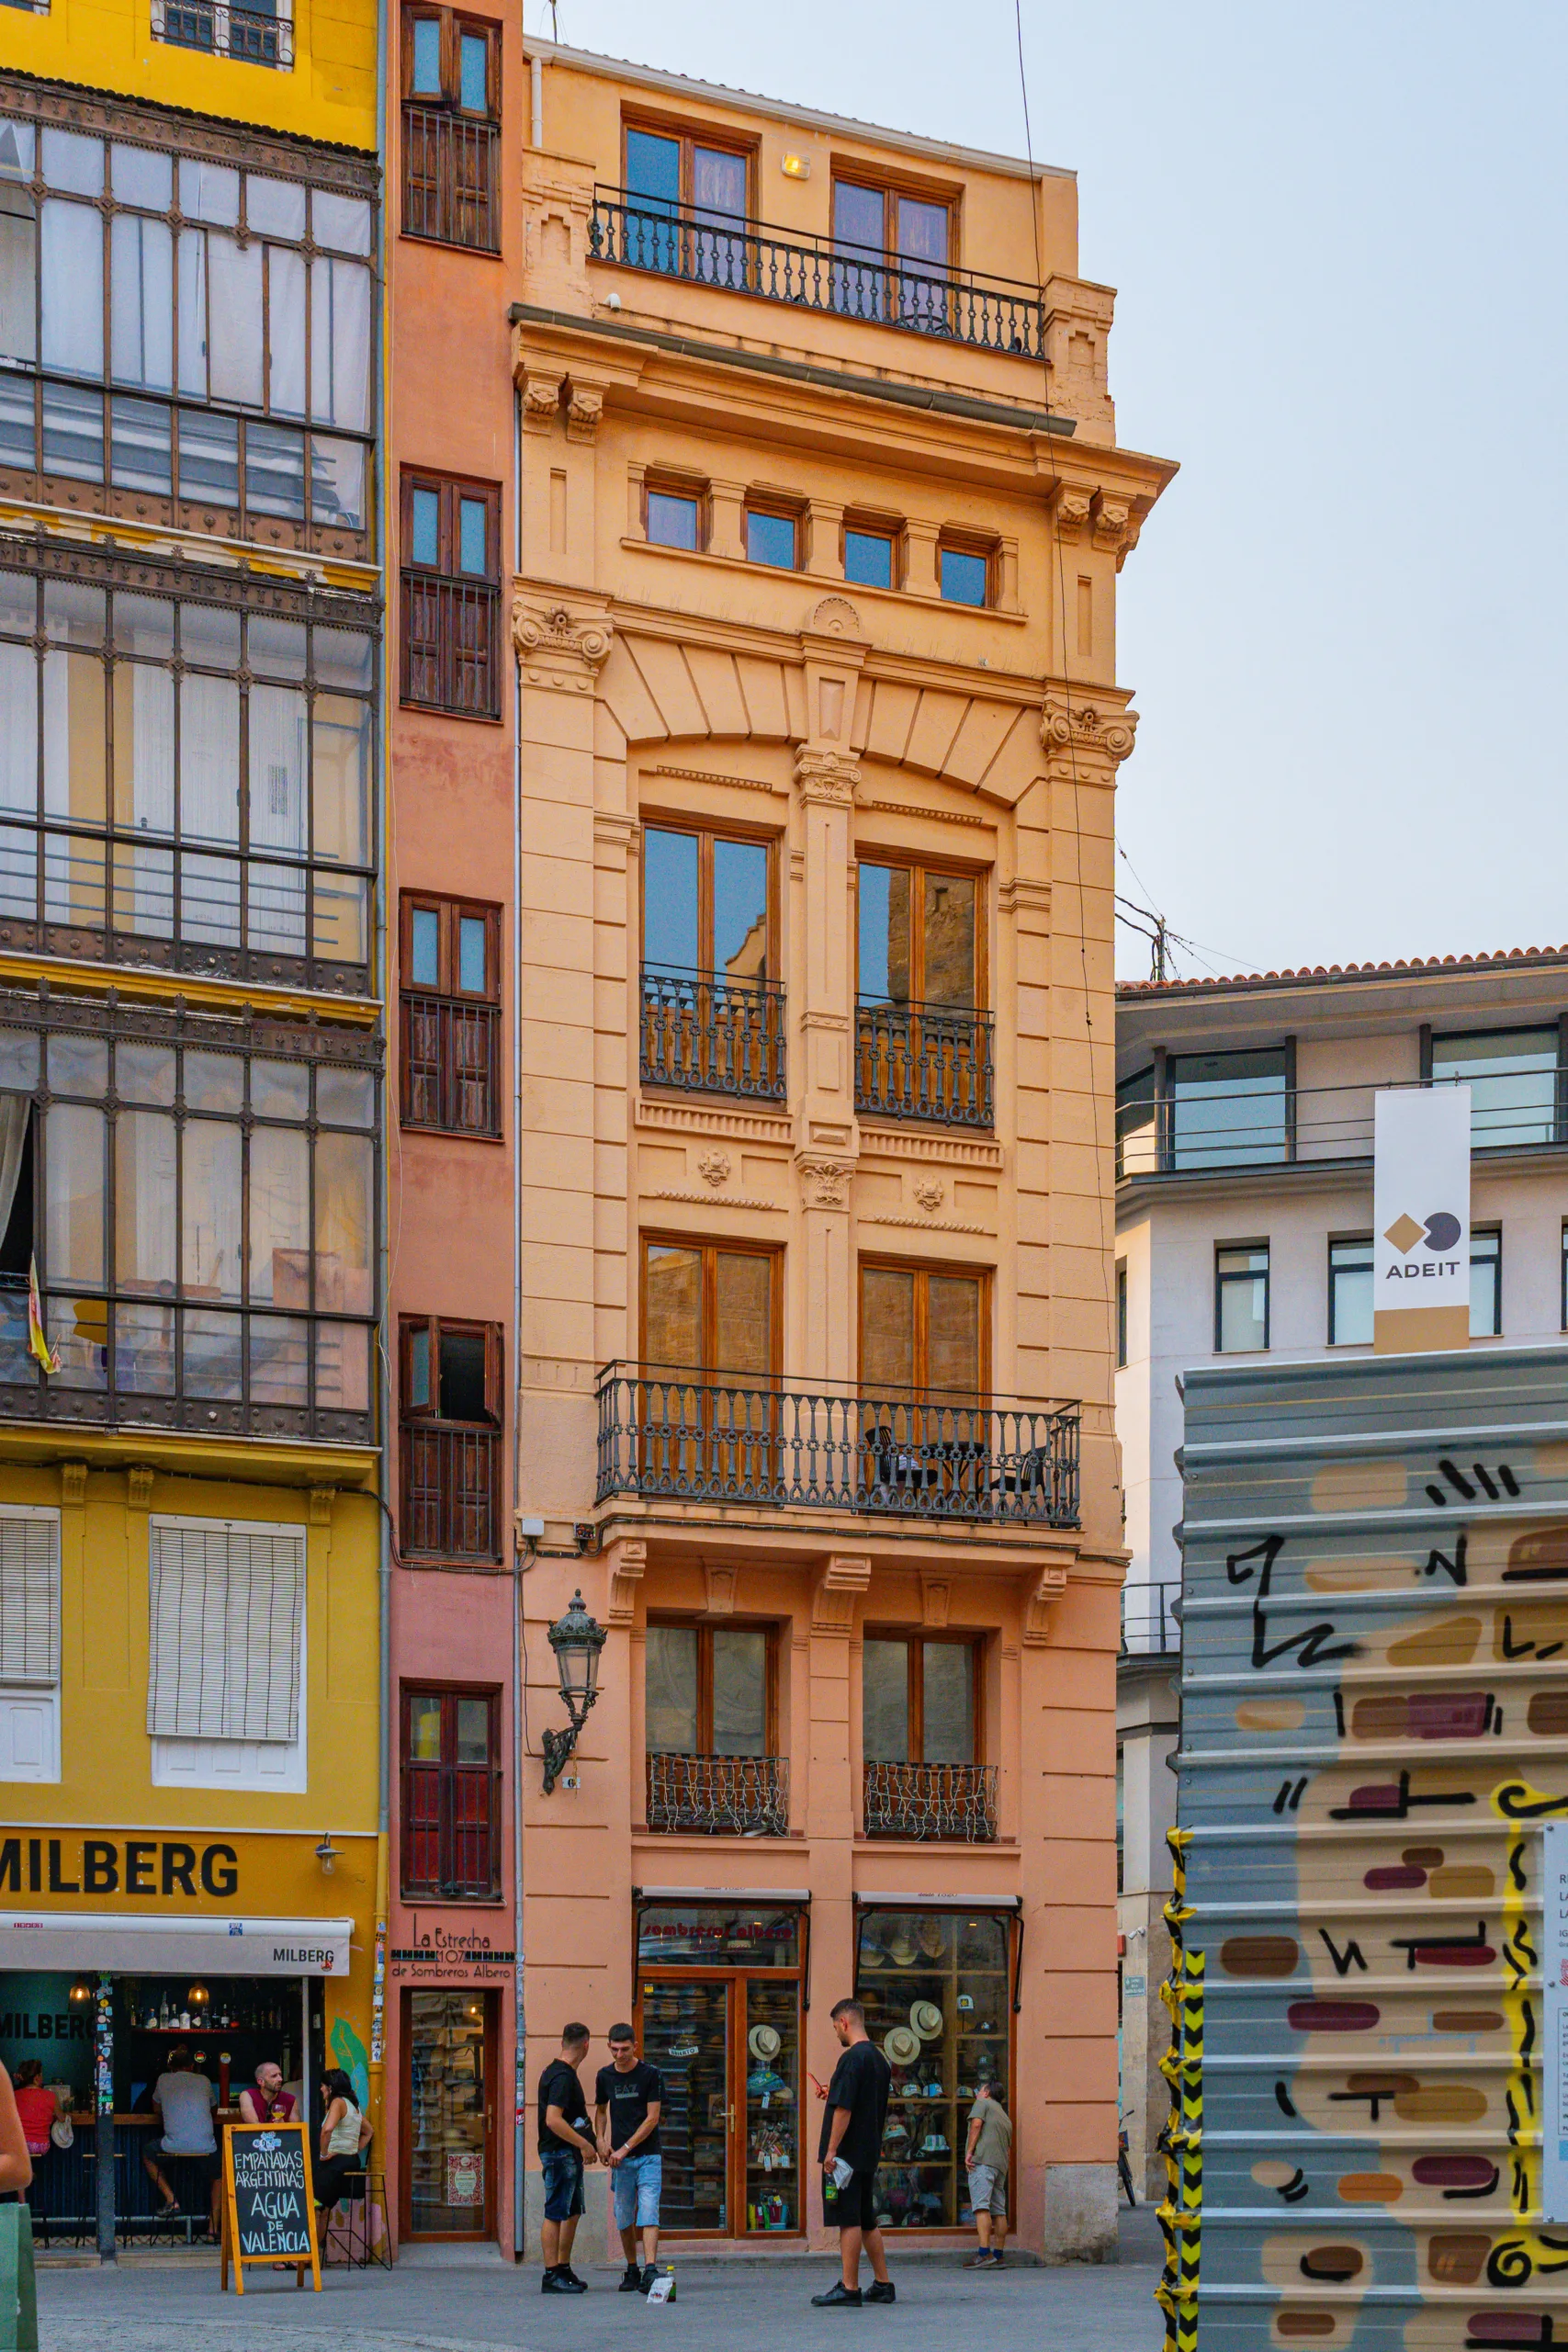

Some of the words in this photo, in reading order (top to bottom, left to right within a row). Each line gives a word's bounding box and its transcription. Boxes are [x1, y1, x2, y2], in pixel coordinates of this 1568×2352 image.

[1385, 1261, 1461, 1279] ADEIT
[413, 1913, 430, 1947] La
[435, 1928, 490, 1948] Estrecha
[273, 1949, 334, 1962] MILBERG
[392, 1963, 407, 1976] de
[411, 1964, 468, 1977] Sombreros
[474, 1965, 511, 1978] Albero
[235, 2169, 304, 2189] ARGENTINAS
[251, 2191, 300, 2220] AGUA
[266, 2220, 283, 2233] DE
[242, 2230, 310, 2254] VALENCIA
